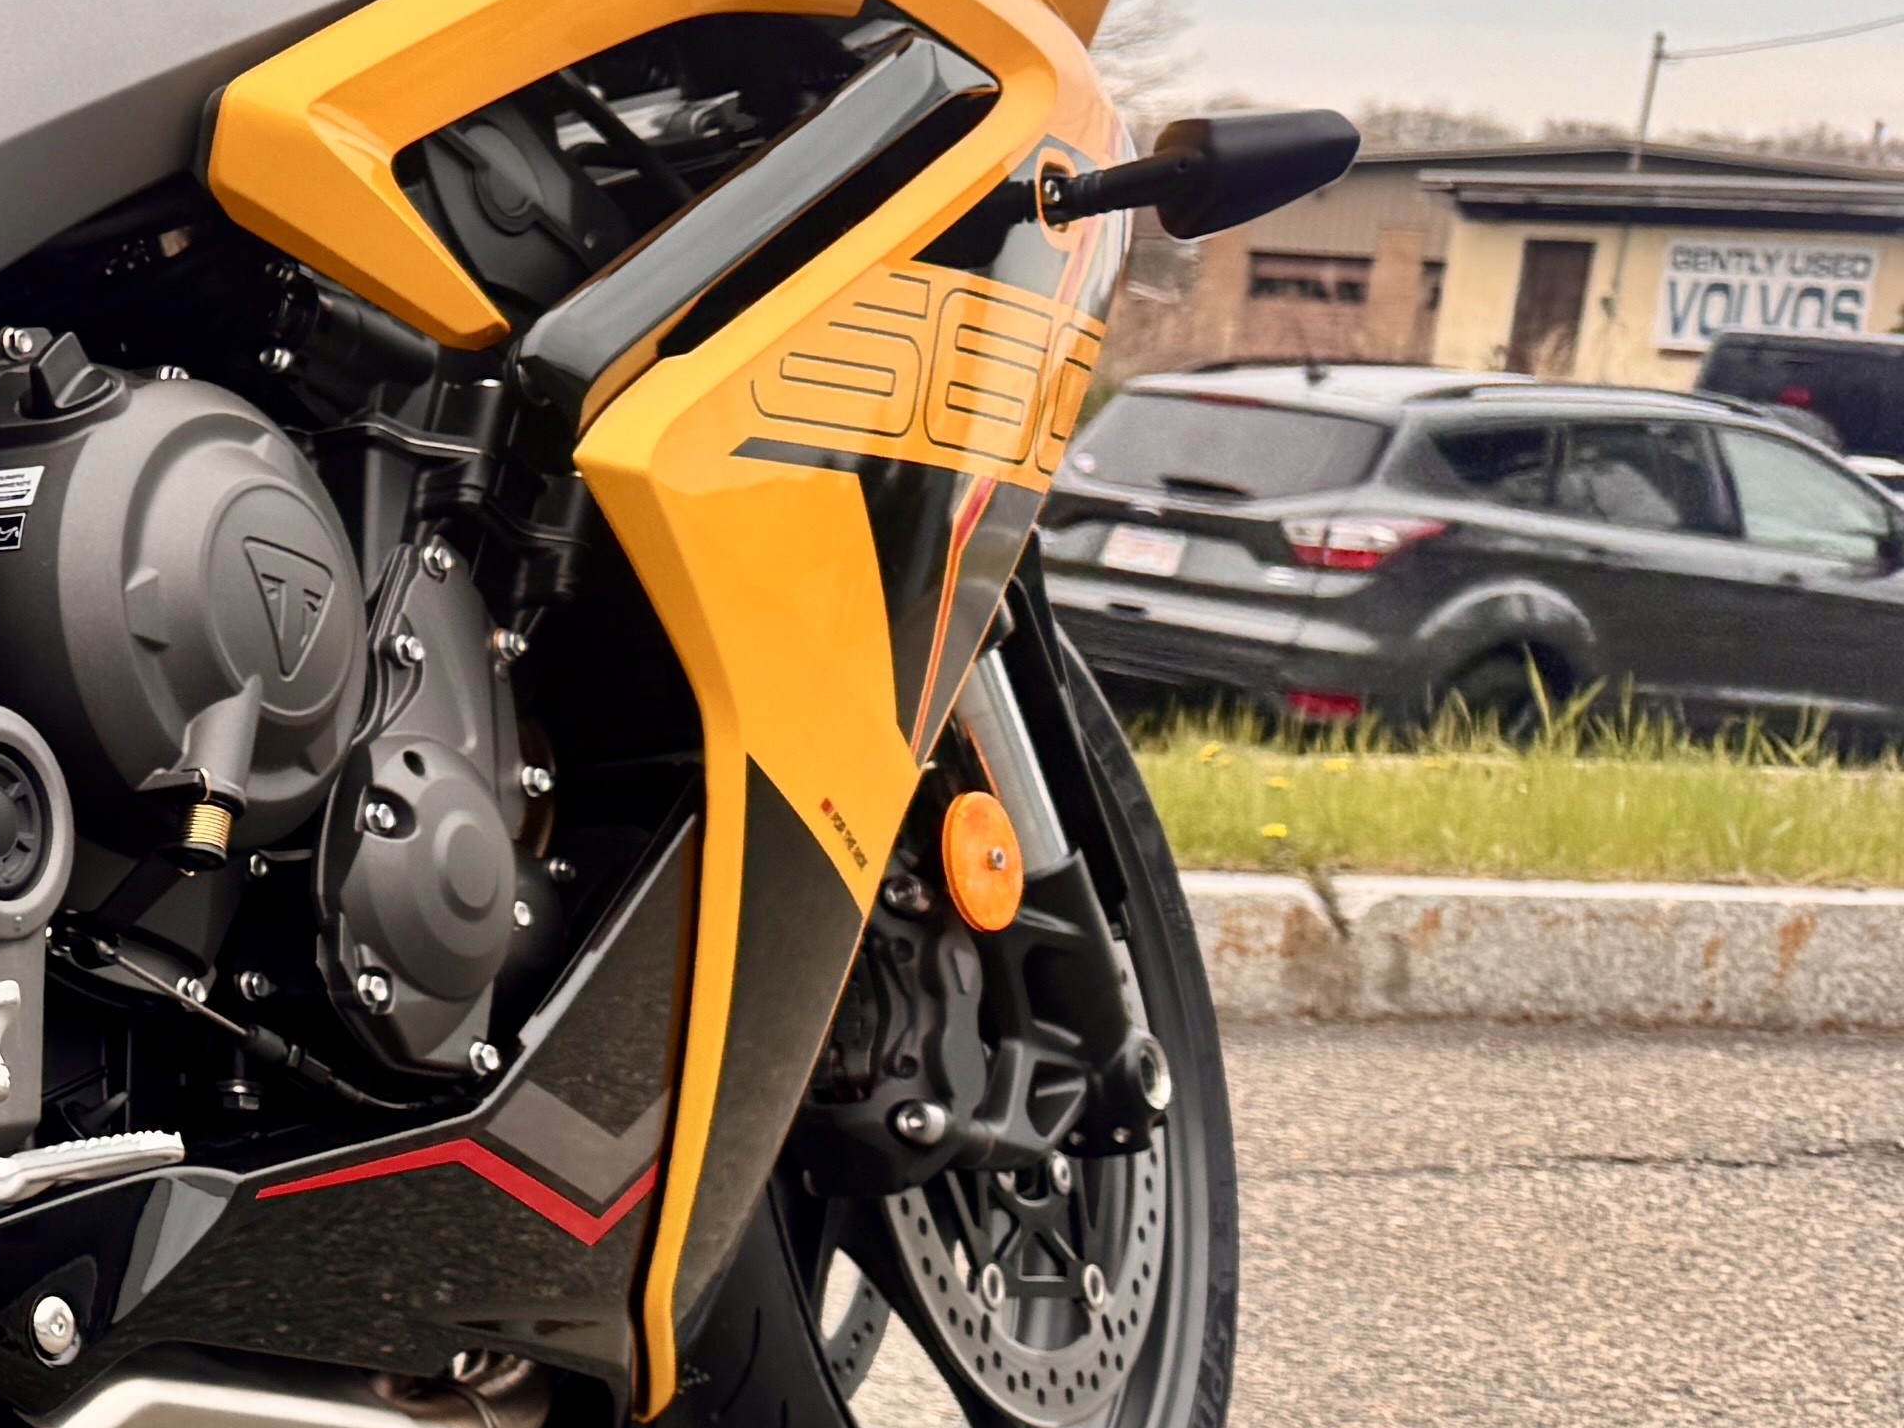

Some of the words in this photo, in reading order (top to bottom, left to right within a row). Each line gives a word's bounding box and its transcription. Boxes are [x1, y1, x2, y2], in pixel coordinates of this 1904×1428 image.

[1670, 244, 1784, 273] GENTLY
[1789, 251, 1873, 280] USED
[1667, 278, 1863, 340] VOLVOS
